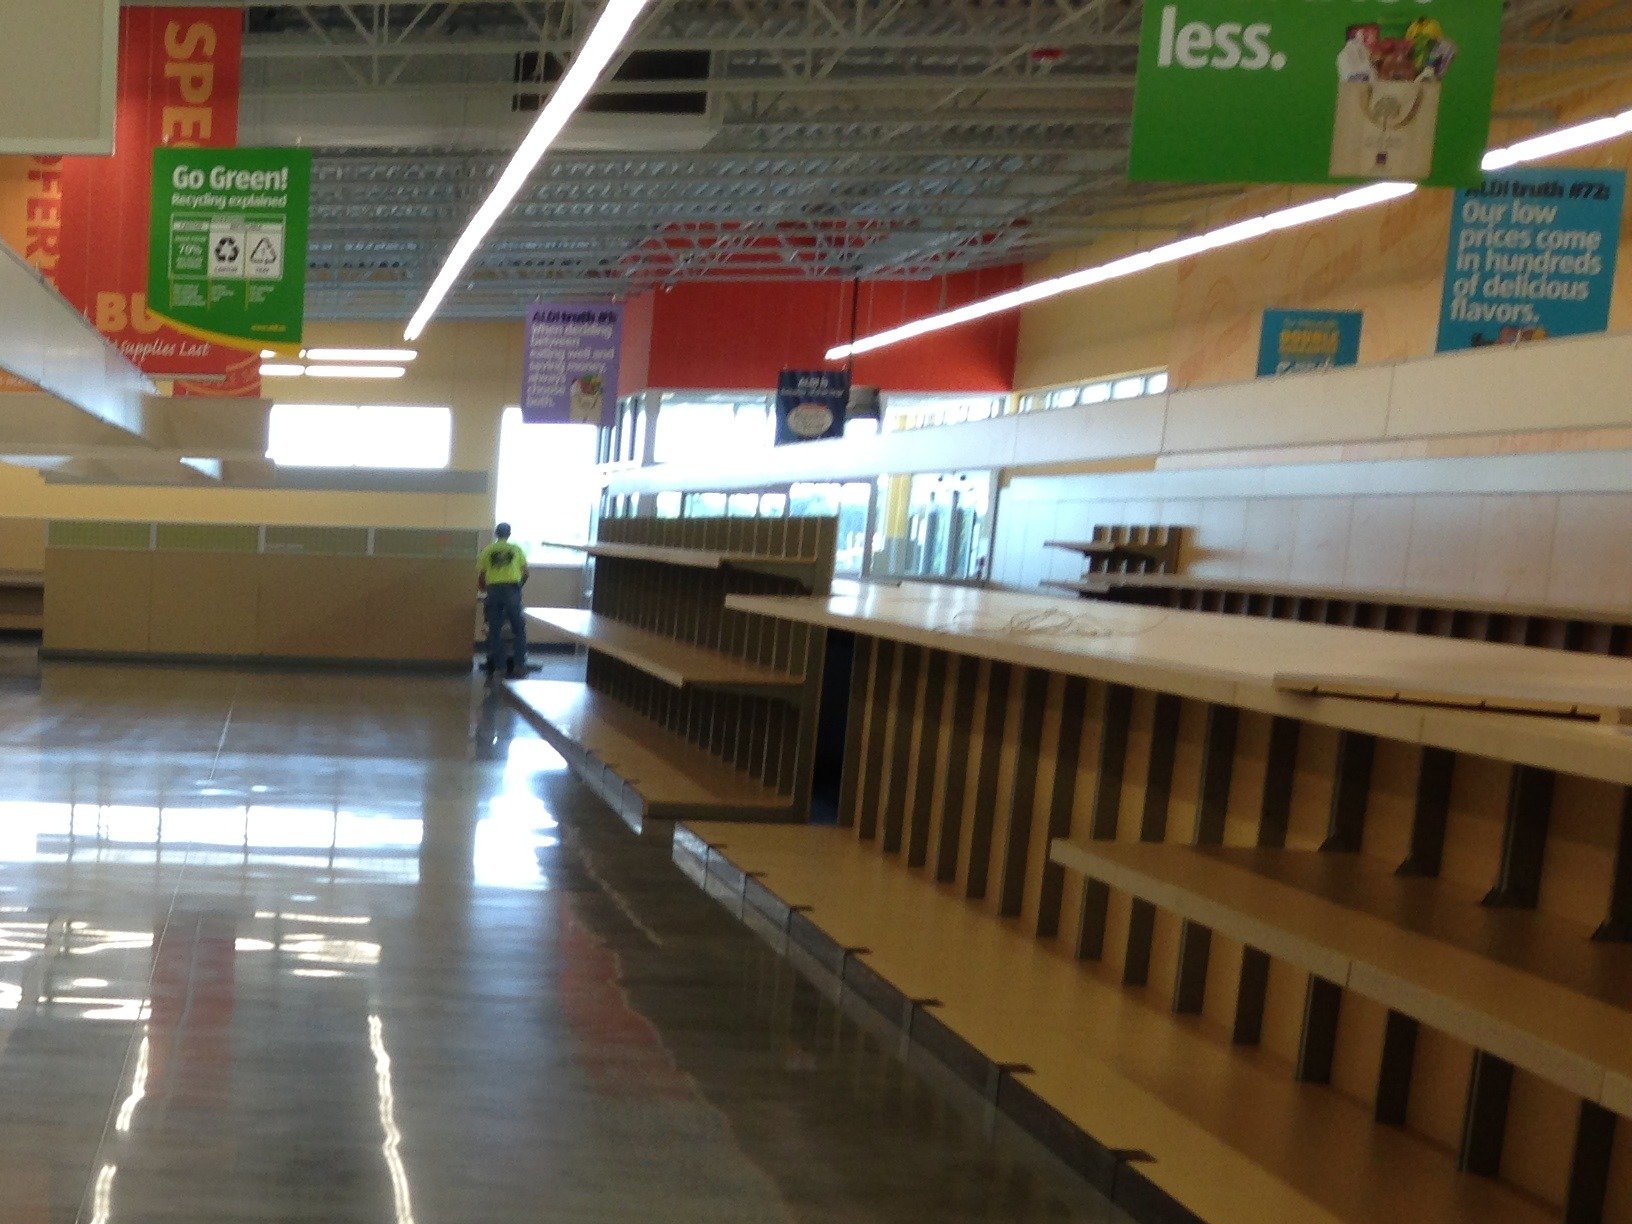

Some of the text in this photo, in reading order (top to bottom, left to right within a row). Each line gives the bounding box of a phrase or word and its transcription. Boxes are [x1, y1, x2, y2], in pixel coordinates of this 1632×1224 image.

[1157, 4, 1288, 71] less.
[163, 20, 217, 147] SPE
[172, 164, 289, 191] Go Green!
[1512, 181, 1565, 198] truth
[171, 192, 288, 210] Recycling explained
[1462, 199, 1558, 224] Our low
[1459, 226, 1602, 252] prices come
[1456, 249, 1602, 276] in hundreds
[1453, 271, 1590, 300] of delicious
[1450, 296, 1540, 323] flavors.
[179, 341, 211, 357] Last
